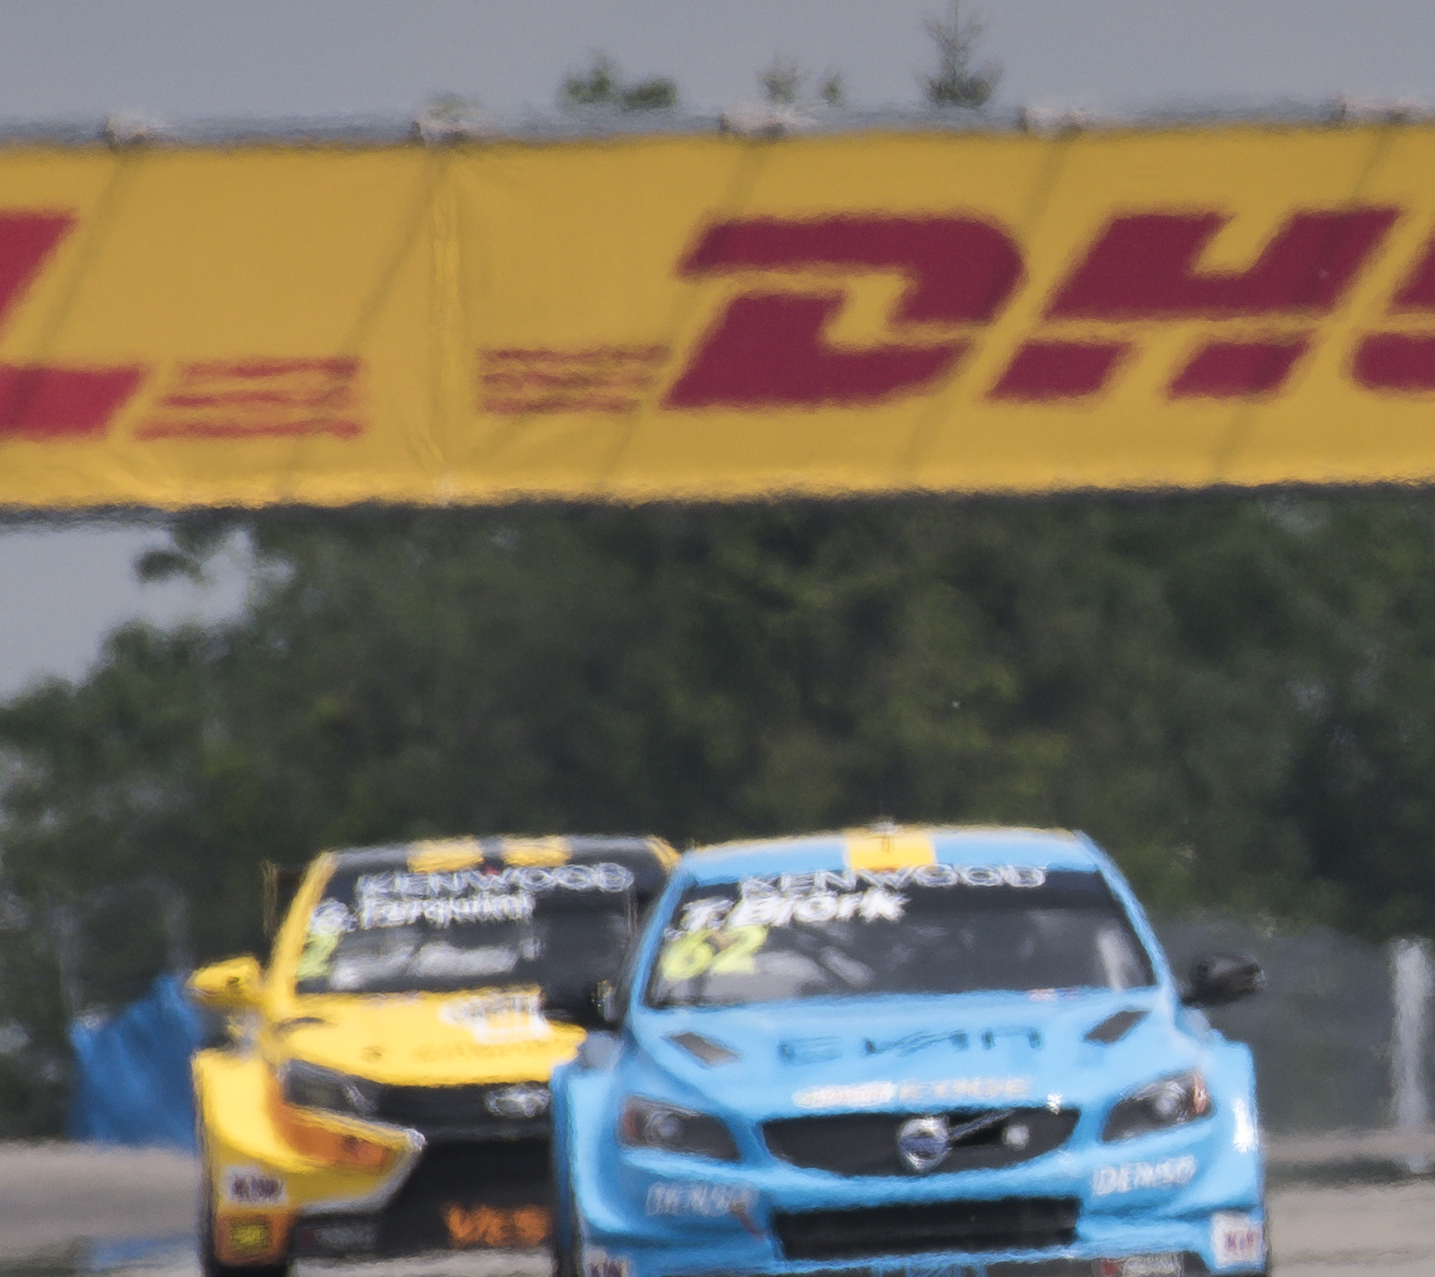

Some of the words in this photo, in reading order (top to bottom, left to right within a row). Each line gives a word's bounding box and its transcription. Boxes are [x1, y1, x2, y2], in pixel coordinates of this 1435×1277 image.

[357, 862, 635, 900] KENWOOD
[739, 863, 1047, 899] KENWOOD
[660, 925, 767, 981] 62
[1092, 1154, 1198, 1195] DENSO
